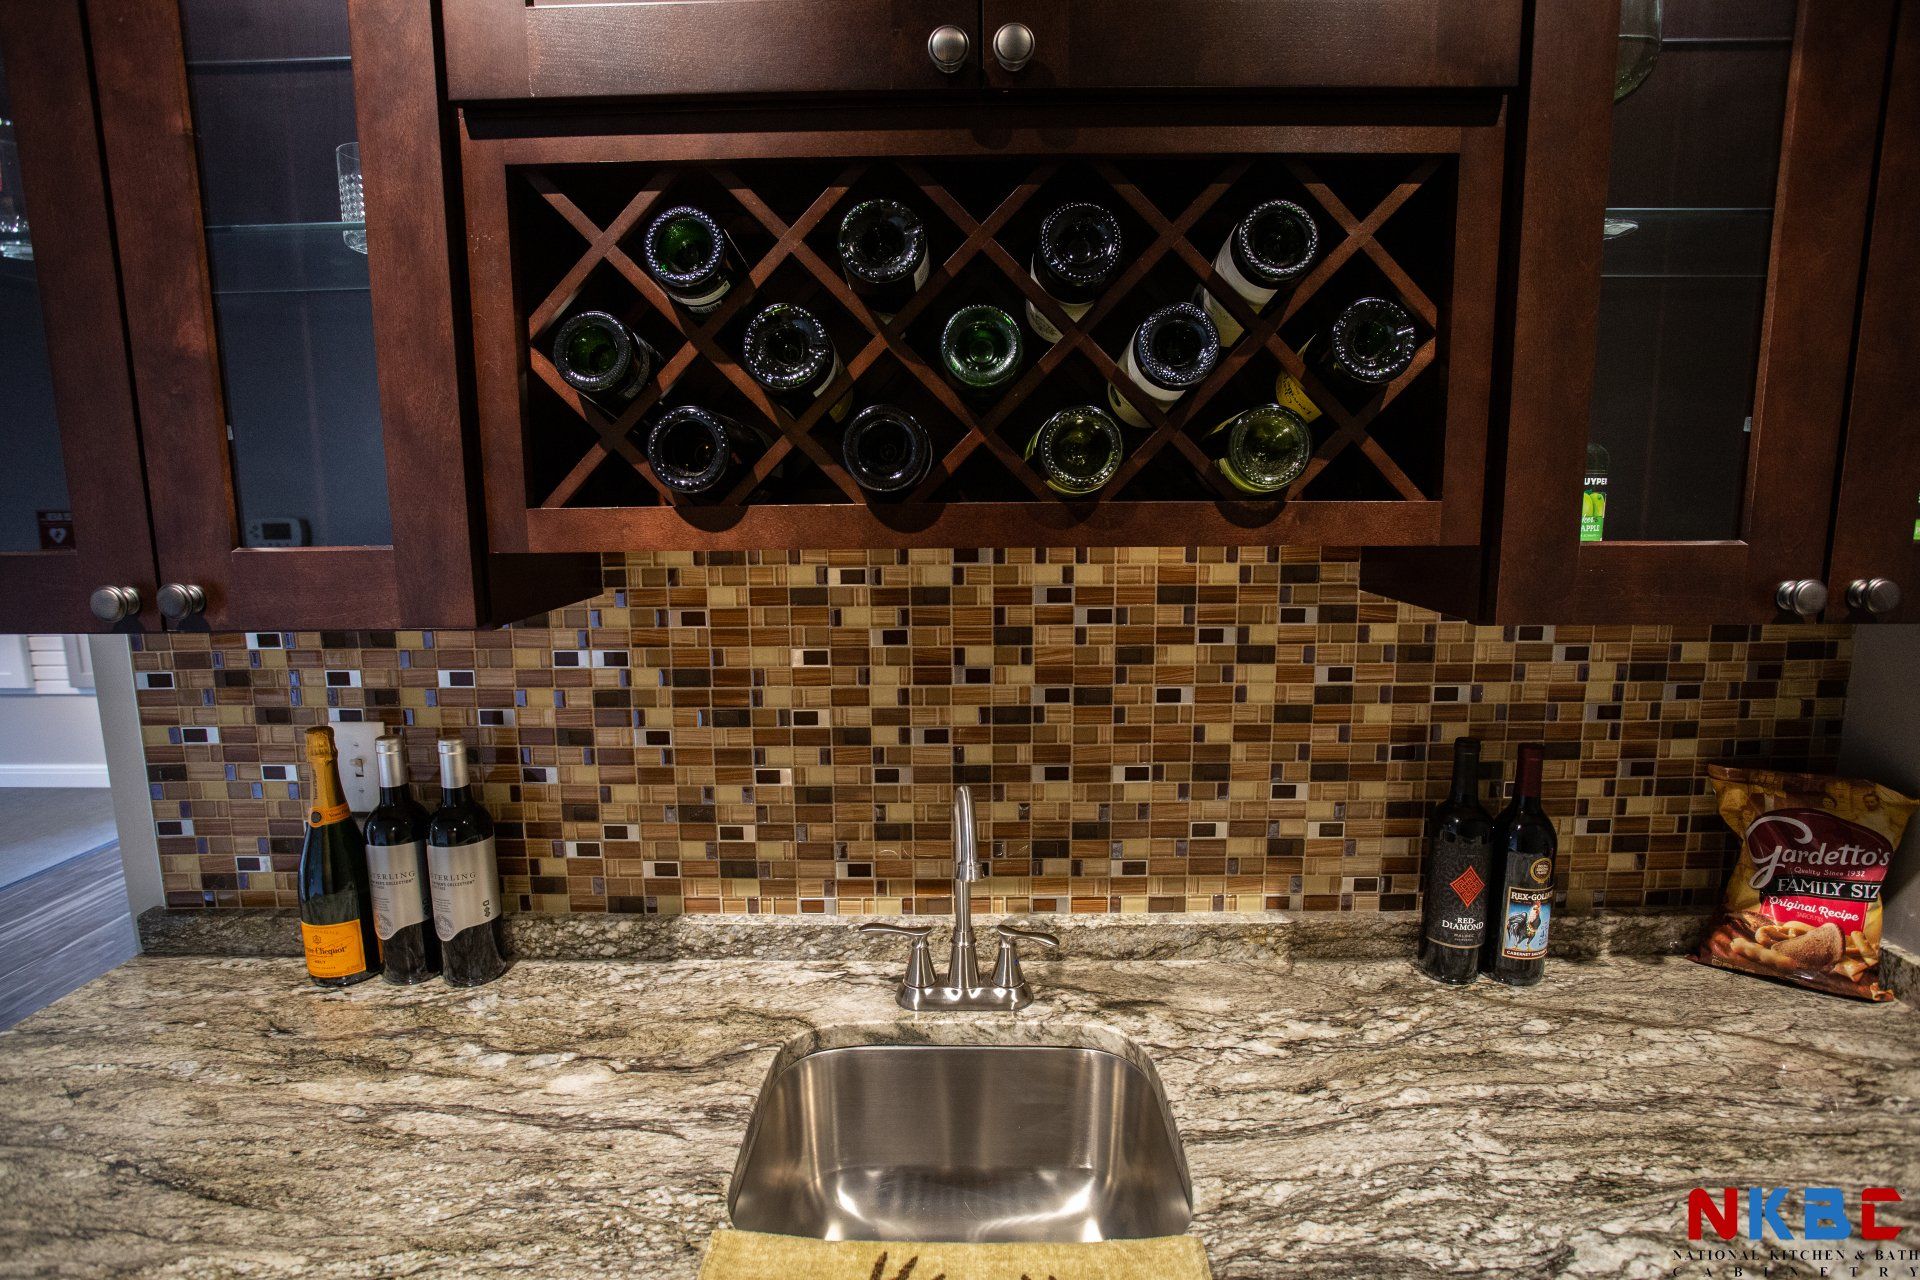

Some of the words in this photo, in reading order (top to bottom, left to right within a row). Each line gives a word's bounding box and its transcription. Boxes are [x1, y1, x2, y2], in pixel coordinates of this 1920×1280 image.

[1745, 815, 1891, 890] Gardetto's
[1794, 866, 1821, 877] Quality
[1823, 869, 1844, 877] Since
[1777, 878, 1846, 897] FAMILY
[1769, 895, 1817, 914] Original
[1818, 905, 1860, 922] Recipe
[1441, 919, 1484, 931] DIAMOND
